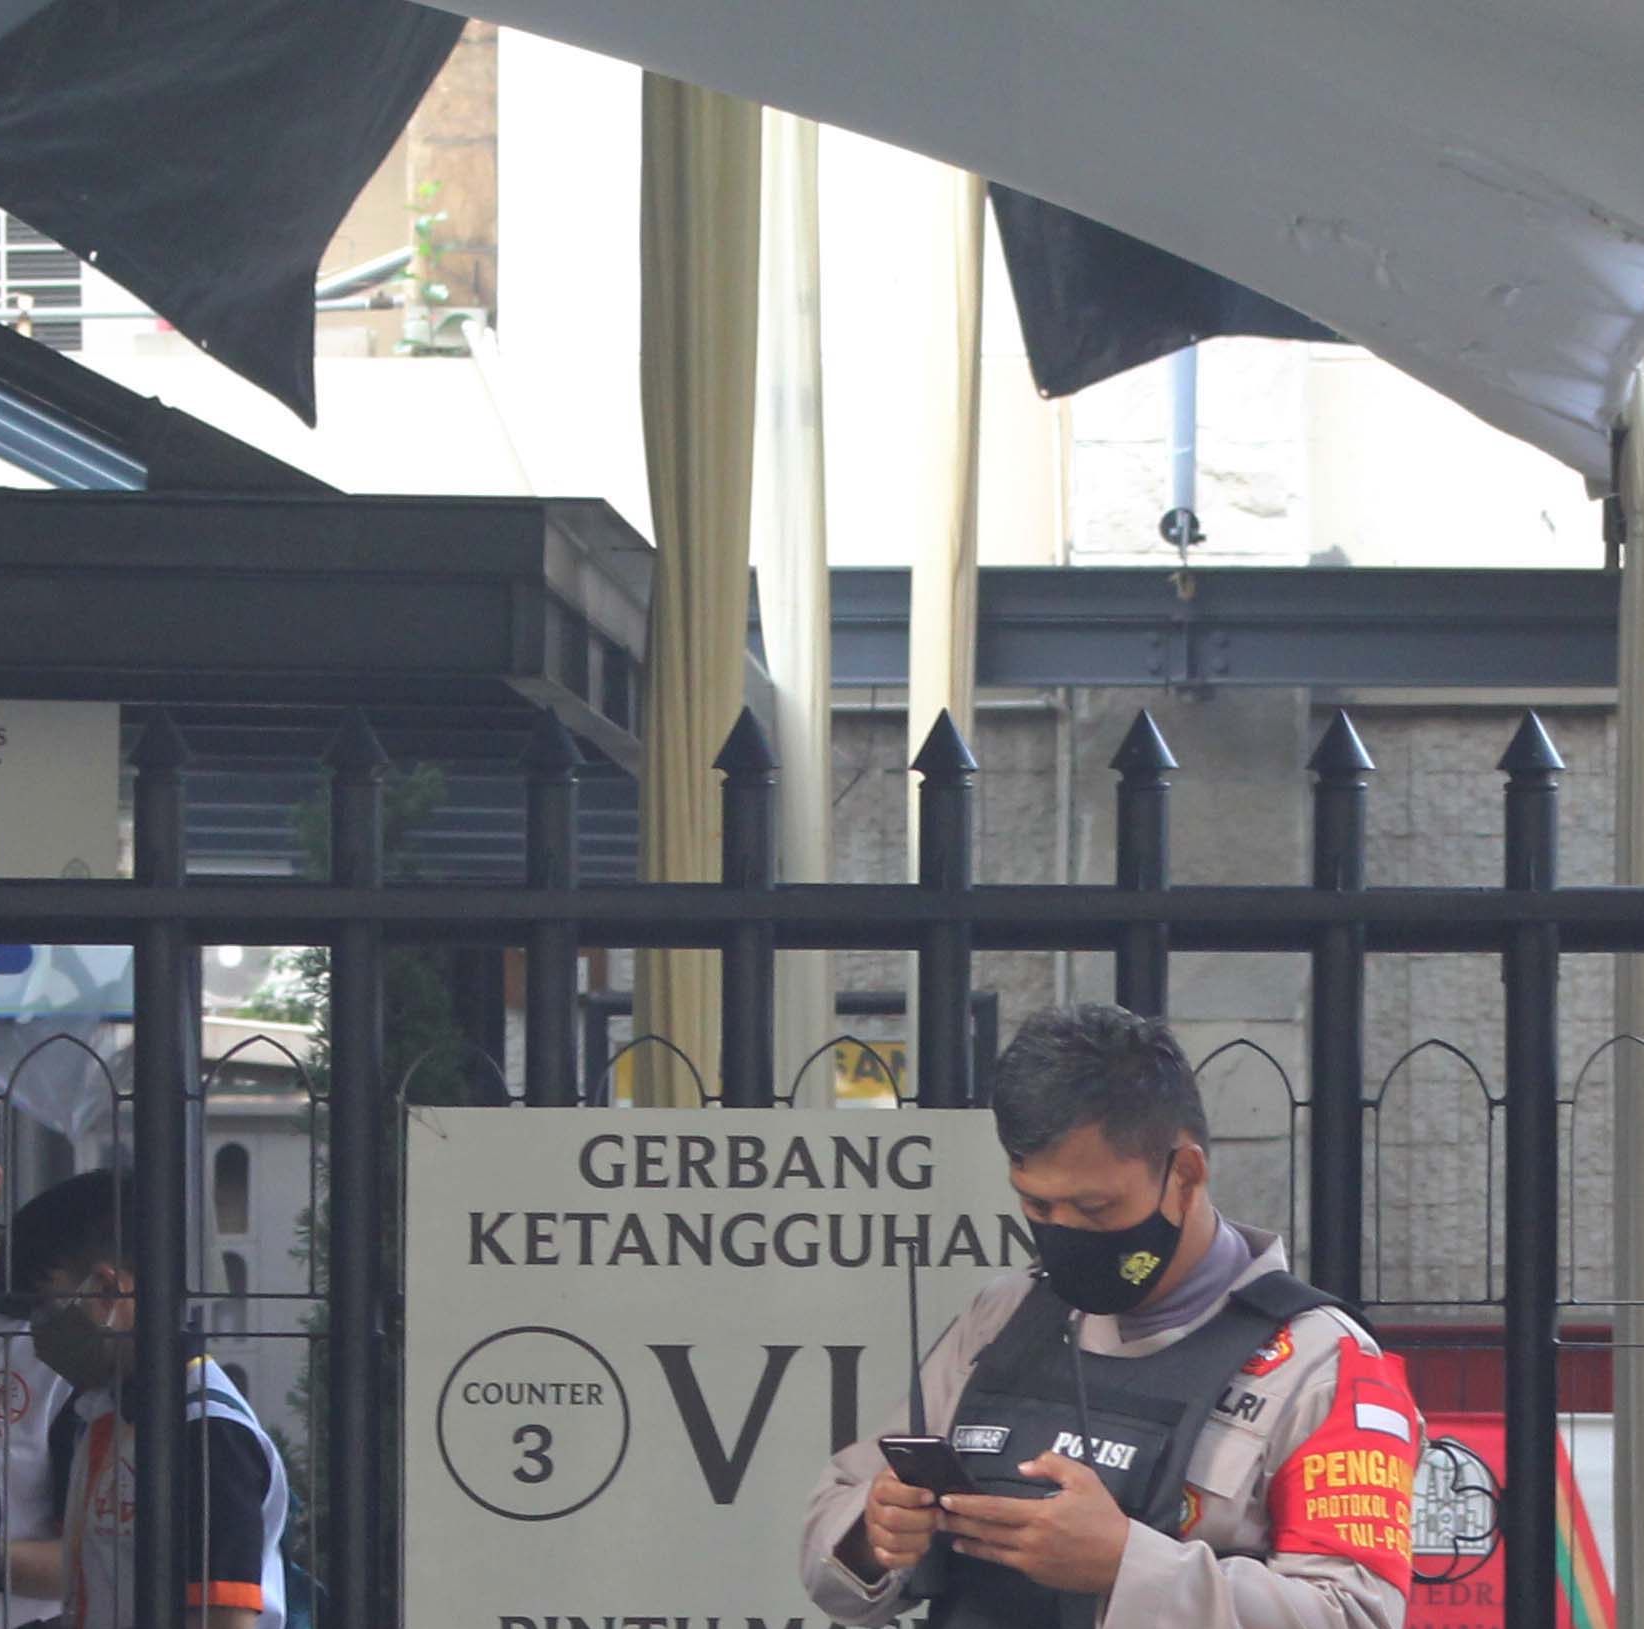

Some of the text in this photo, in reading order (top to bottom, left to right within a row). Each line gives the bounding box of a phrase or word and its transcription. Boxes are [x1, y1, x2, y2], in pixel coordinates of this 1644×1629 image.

[579, 1134, 933, 1190] GERBANG
[469, 1213, 1040, 1268] KETANGGUHAN
[463, 1381, 604, 1406] COUNTER
[512, 1423, 554, 1484] 3
